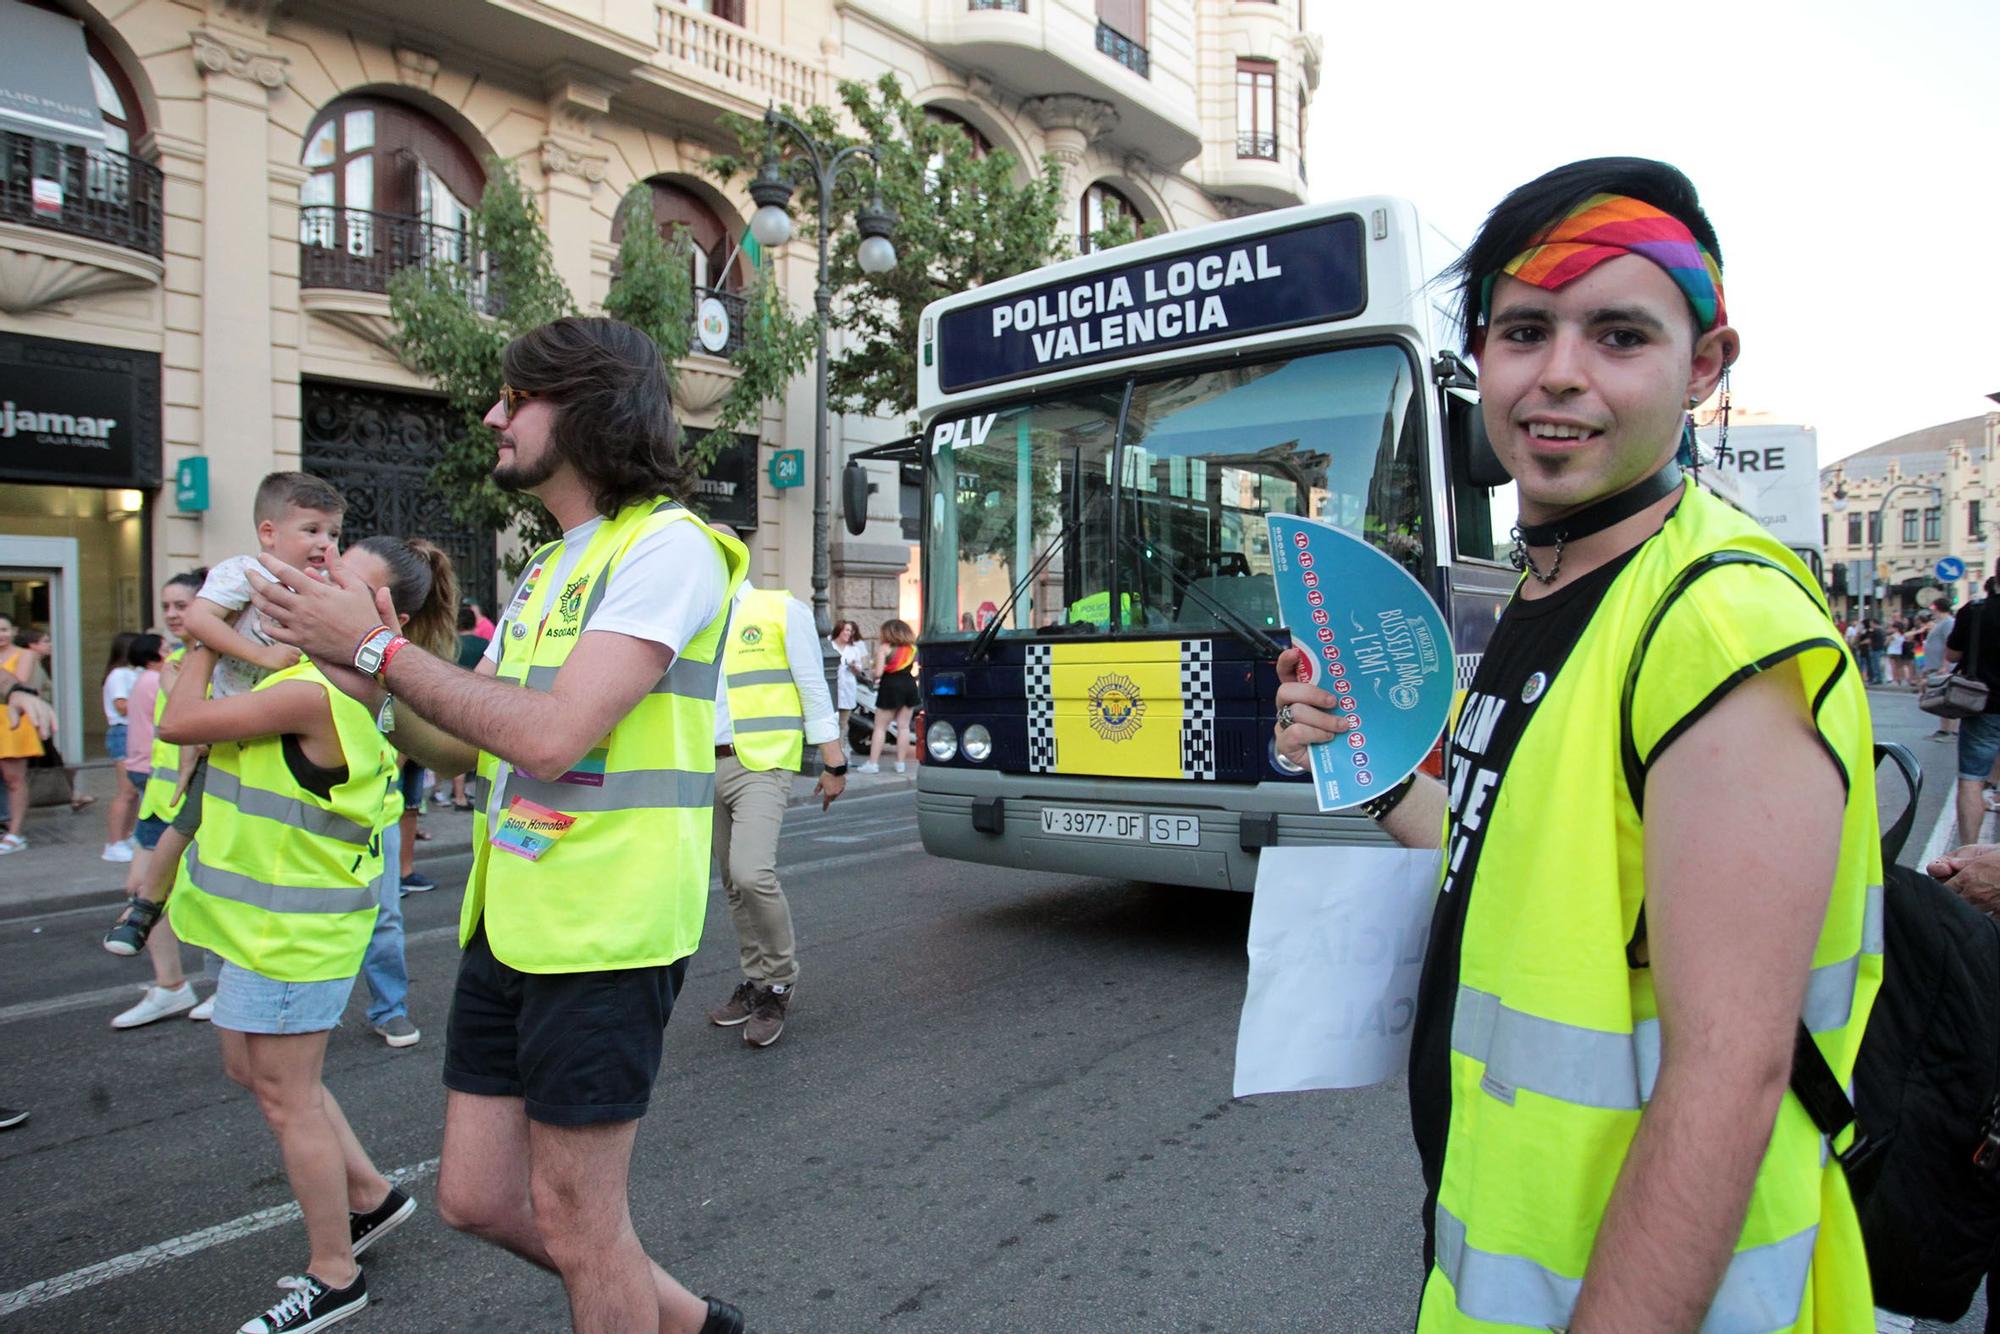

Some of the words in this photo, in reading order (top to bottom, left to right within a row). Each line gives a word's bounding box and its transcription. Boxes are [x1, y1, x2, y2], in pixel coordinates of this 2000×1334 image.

[992, 277, 1135, 338] POLICIA
[1143, 244, 1282, 302] LOCAL
[1031, 295, 1229, 364] VALENCIA
[931, 412, 998, 456] PLV
[697, 480, 738, 496] mar
[1350, 633, 1390, 675] L'EMT
[1377, 608, 1416, 661] BUSSEJA
[1394, 663, 1424, 688] AMB
[504, 817, 526, 832] Stop
